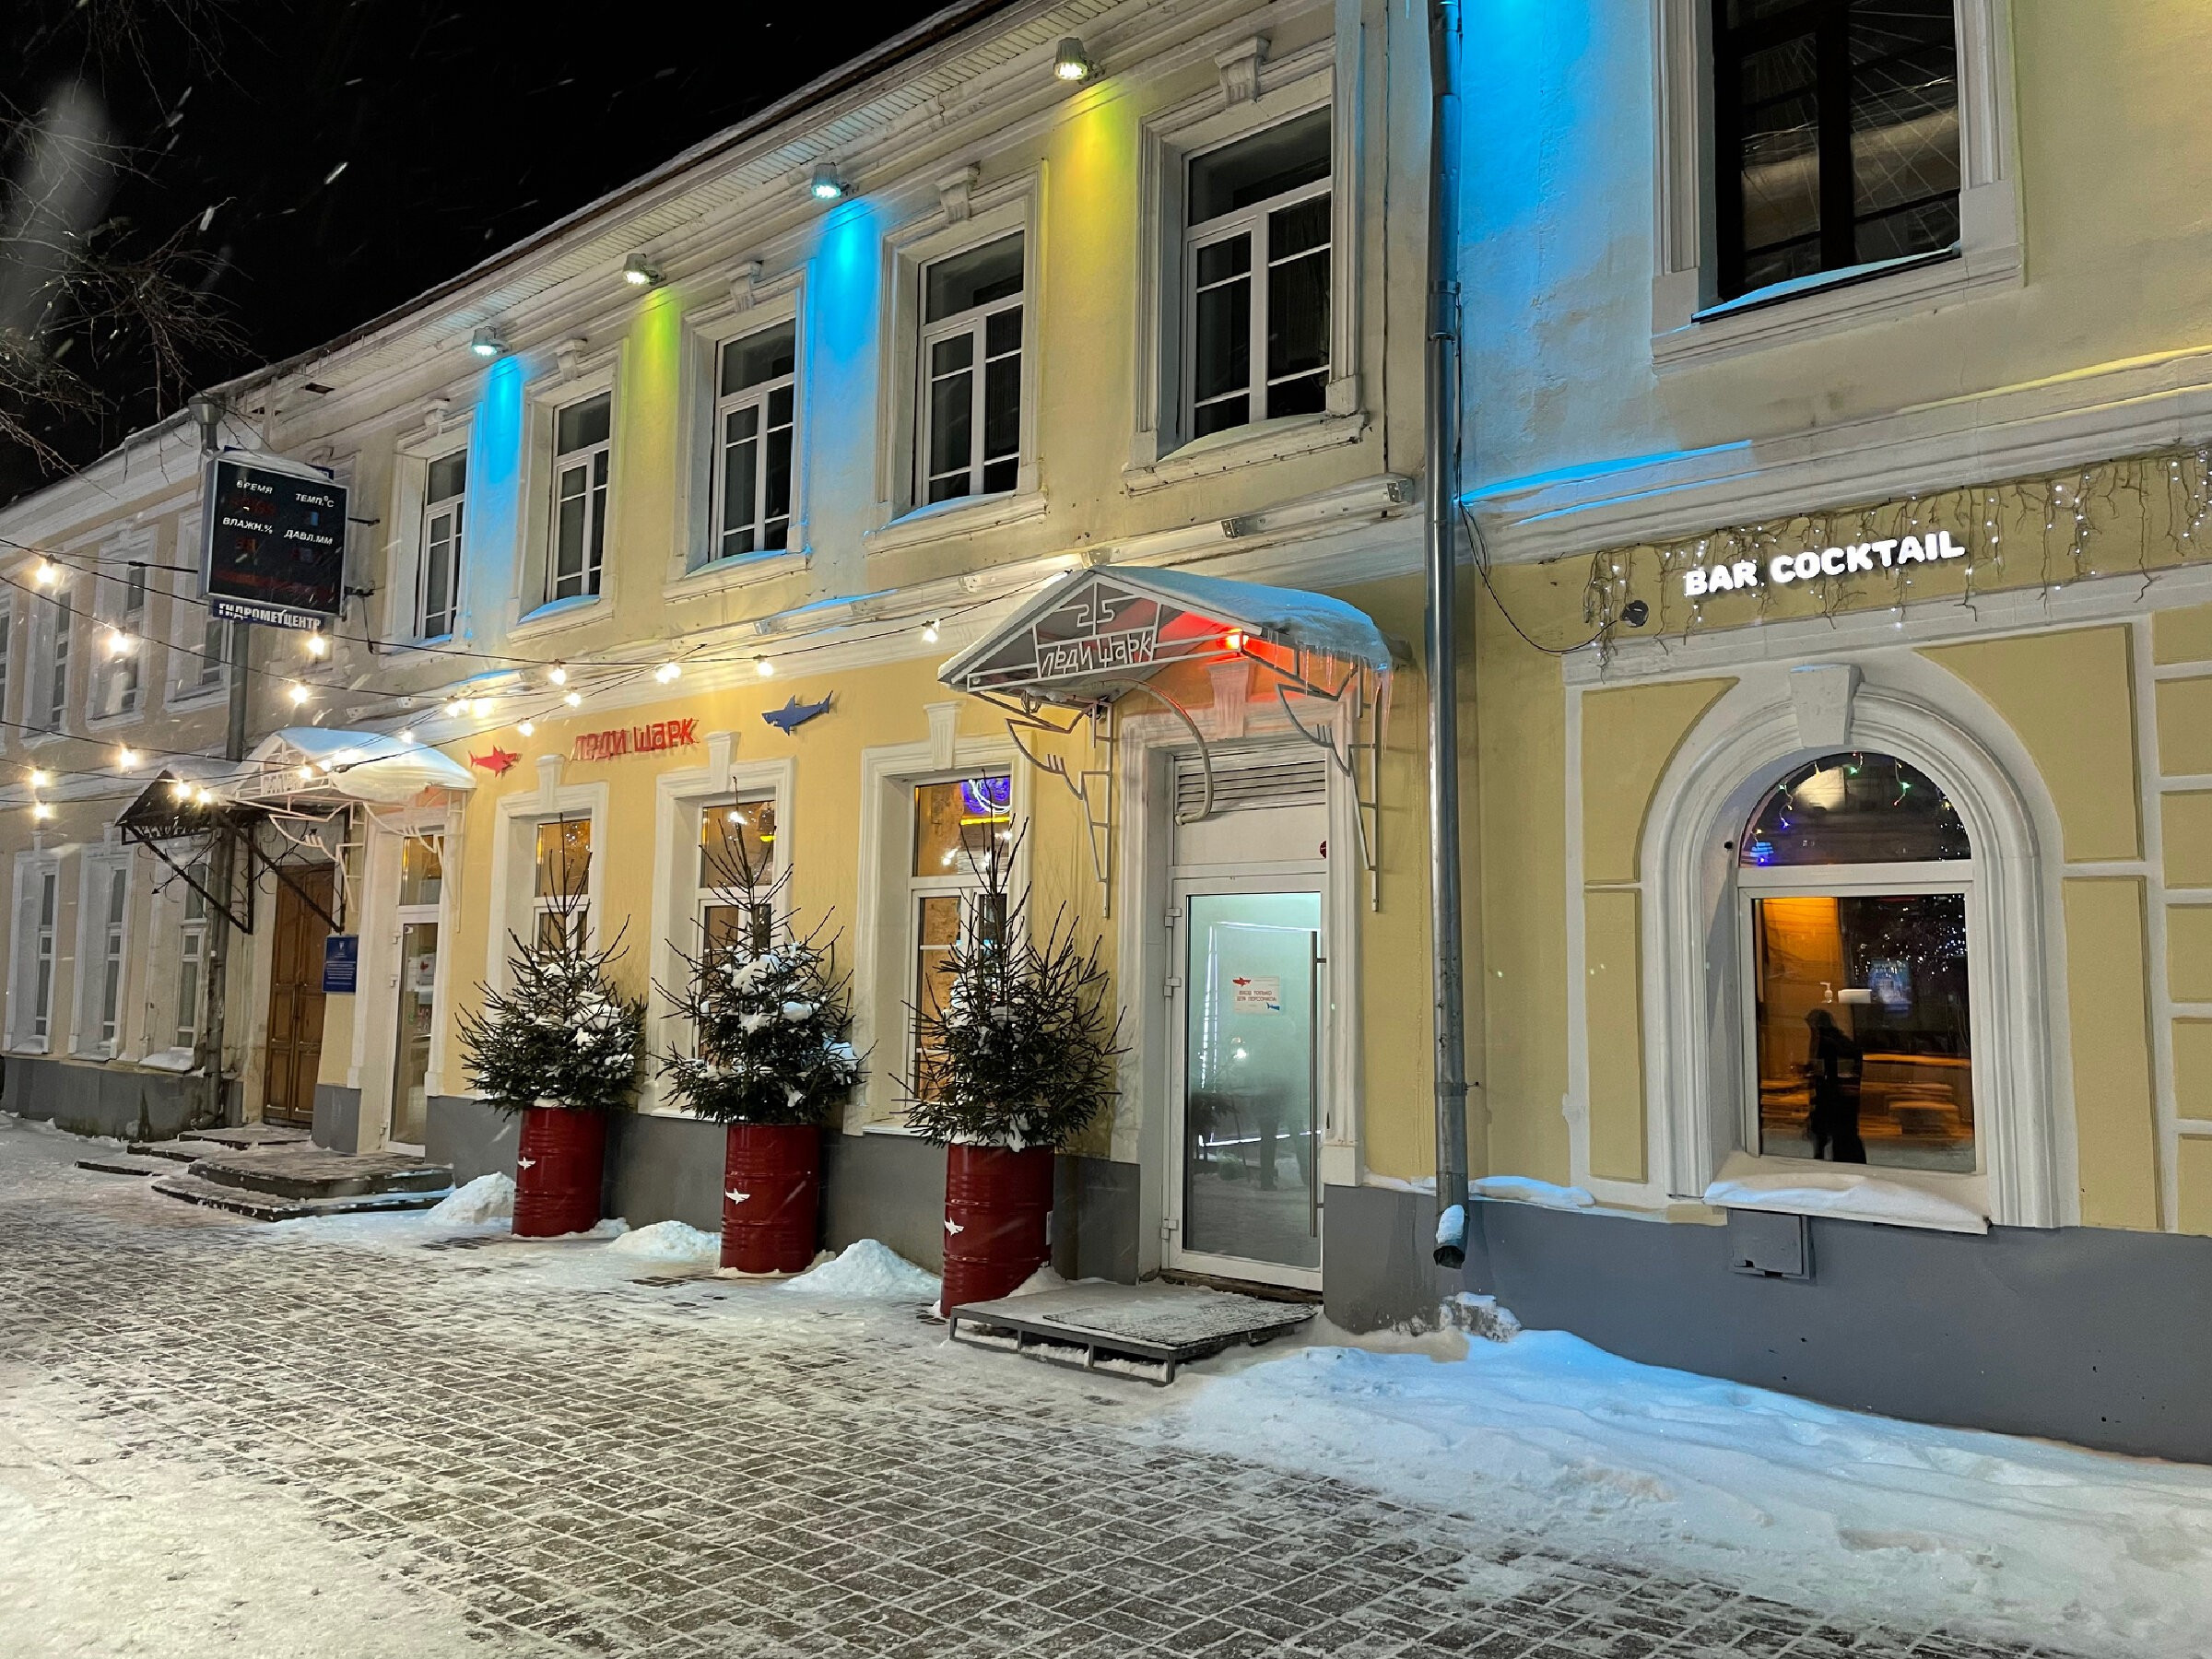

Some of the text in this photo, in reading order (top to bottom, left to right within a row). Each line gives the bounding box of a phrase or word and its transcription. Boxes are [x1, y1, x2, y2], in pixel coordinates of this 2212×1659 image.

[236, 480, 273, 494] ВРЕМЯ
[1685, 530, 1965, 595] BAR COCKTAIL
